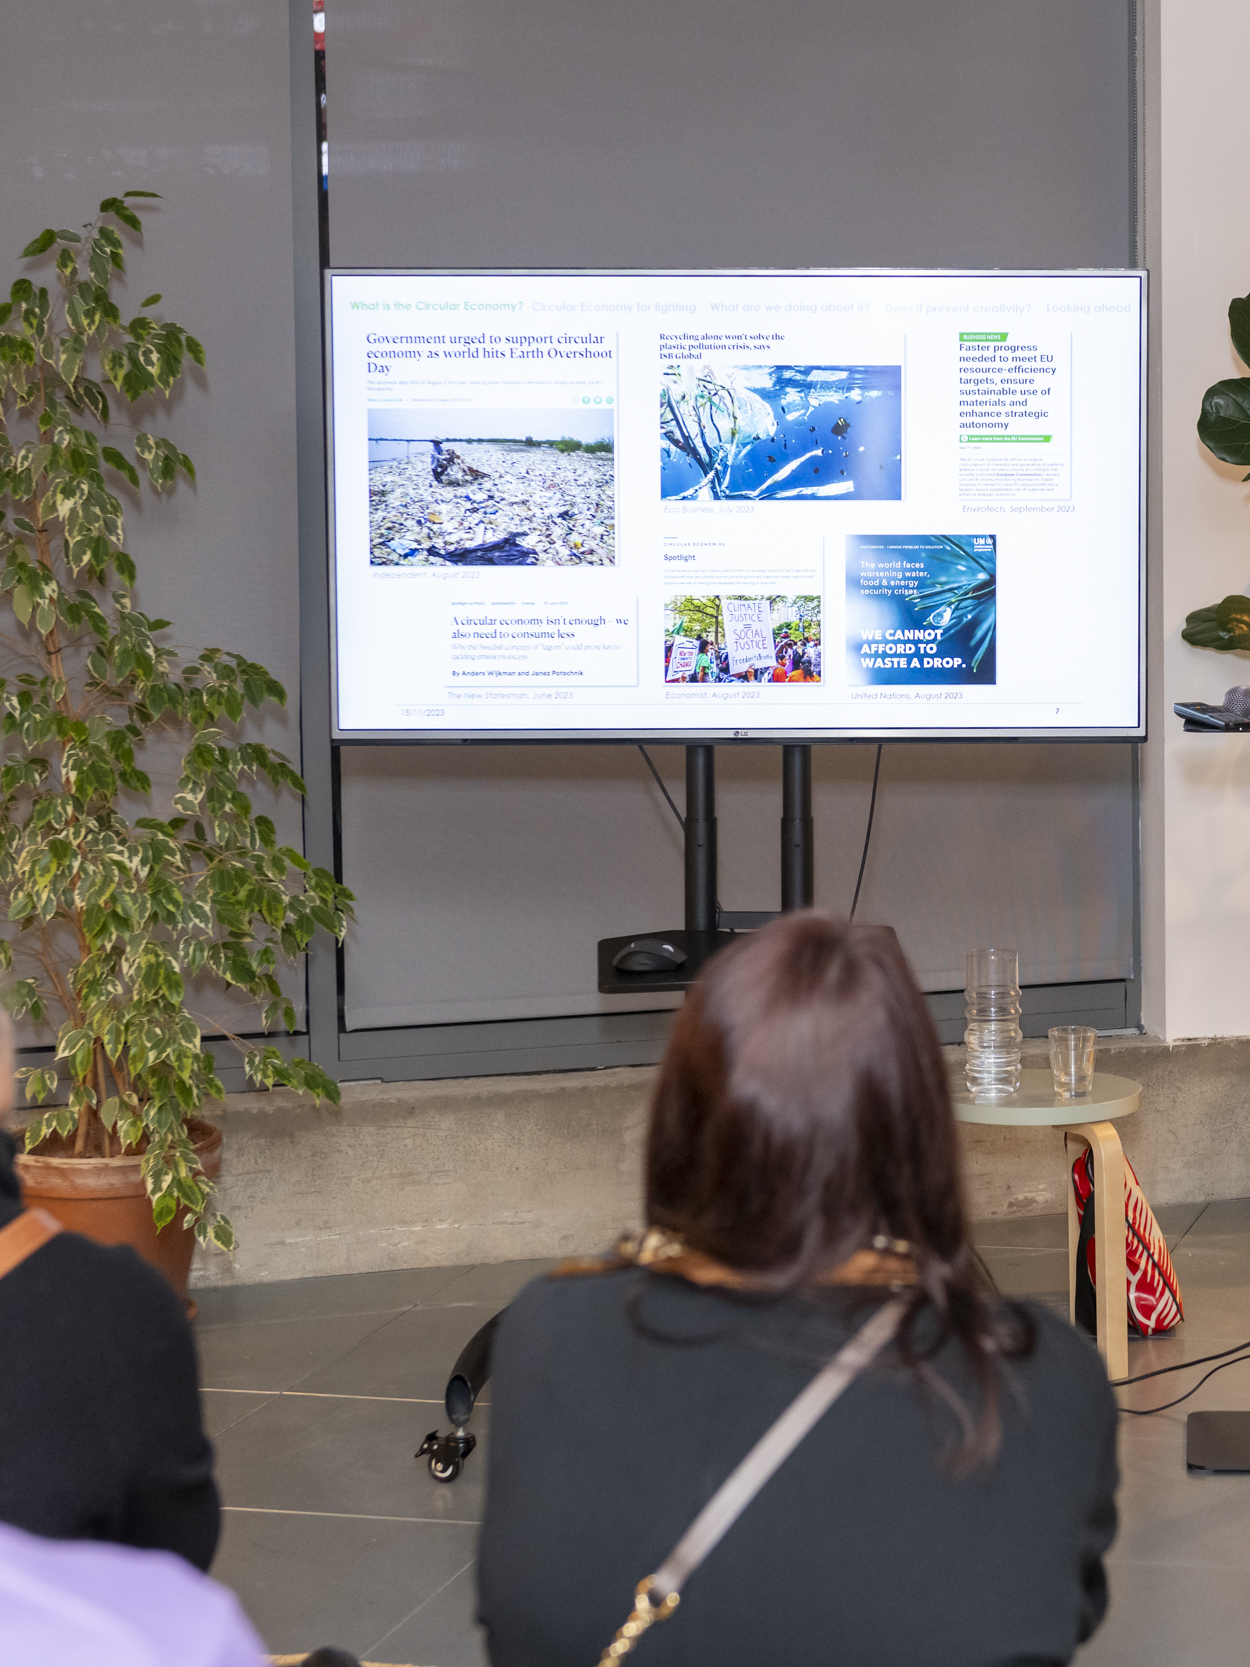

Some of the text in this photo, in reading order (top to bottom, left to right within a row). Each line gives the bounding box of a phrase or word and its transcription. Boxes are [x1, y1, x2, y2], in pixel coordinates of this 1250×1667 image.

[350, 301, 524, 312] What is the Circular Economy?
[532, 302, 696, 314] Circular Economy for lighting
[710, 302, 739, 312] What
[784, 302, 817, 314] doing
[820, 302, 854, 312] about
[857, 302, 870, 312] it?
[886, 304, 1032, 315] Does it prevent creativity?
[1046, 303, 1131, 314] Looking ahead
[366, 333, 605, 347] Government urged to support circular
[660, 333, 699, 341] Recycling
[660, 342, 686, 351] plastic
[688, 342, 726, 352] pollution
[994, 345, 1038, 353] progress
[366, 348, 612, 361] economy as world hits Earth Overshoot
[959, 354, 996, 362] needed
[1040, 354, 1053, 362] EU
[367, 363, 391, 375] Day
[959, 365, 1056, 376] resource-efficiency
[959, 377, 997, 386] targets,
[960, 387, 1017, 395] sustainable
[1040, 387, 1051, 396] of
[959, 398, 1028, 406] materials and
[959, 409, 1048, 419] enhance strategic
[959, 421, 1009, 430] autonomy
[664, 506, 680, 514] Eco
[682, 506, 715, 514] Business,
[718, 506, 734, 514] July
[962, 505, 1007, 513] Envirotech,
[1010, 505, 1055, 514] September
[664, 554, 696, 562] Spotlight
[373, 571, 428, 579] Independent,
[432, 572, 459, 580] August
[860, 570, 930, 578] worsening water,
[890, 580, 919, 588] energy
[860, 588, 892, 596] security
[727, 602, 764, 613] CLIMATE
[452, 616, 459, 626] A
[460, 616, 497, 626] circular
[499, 618, 543, 627] economy
[546, 616, 566, 625] isn't
[568, 616, 606, 628] enough
[729, 613, 764, 622] JUSTICE
[451, 629, 471, 638] also
[473, 629, 497, 639] need
[558, 629, 575, 638] less
[733, 628, 767, 640] SOCIAL
[861, 629, 944, 640] WE CANNOT
[734, 640, 768, 651] JUSTICE
[860, 643, 937, 654] AFFORD TO
[861, 657, 966, 668] WASTE A DROP.
[448, 692, 462, 700] The
[711, 692, 740, 700] August
[914, 692, 943, 701] August
[944, 692, 963, 700] 2023
[401, 708, 445, 716] 15/11/2023
